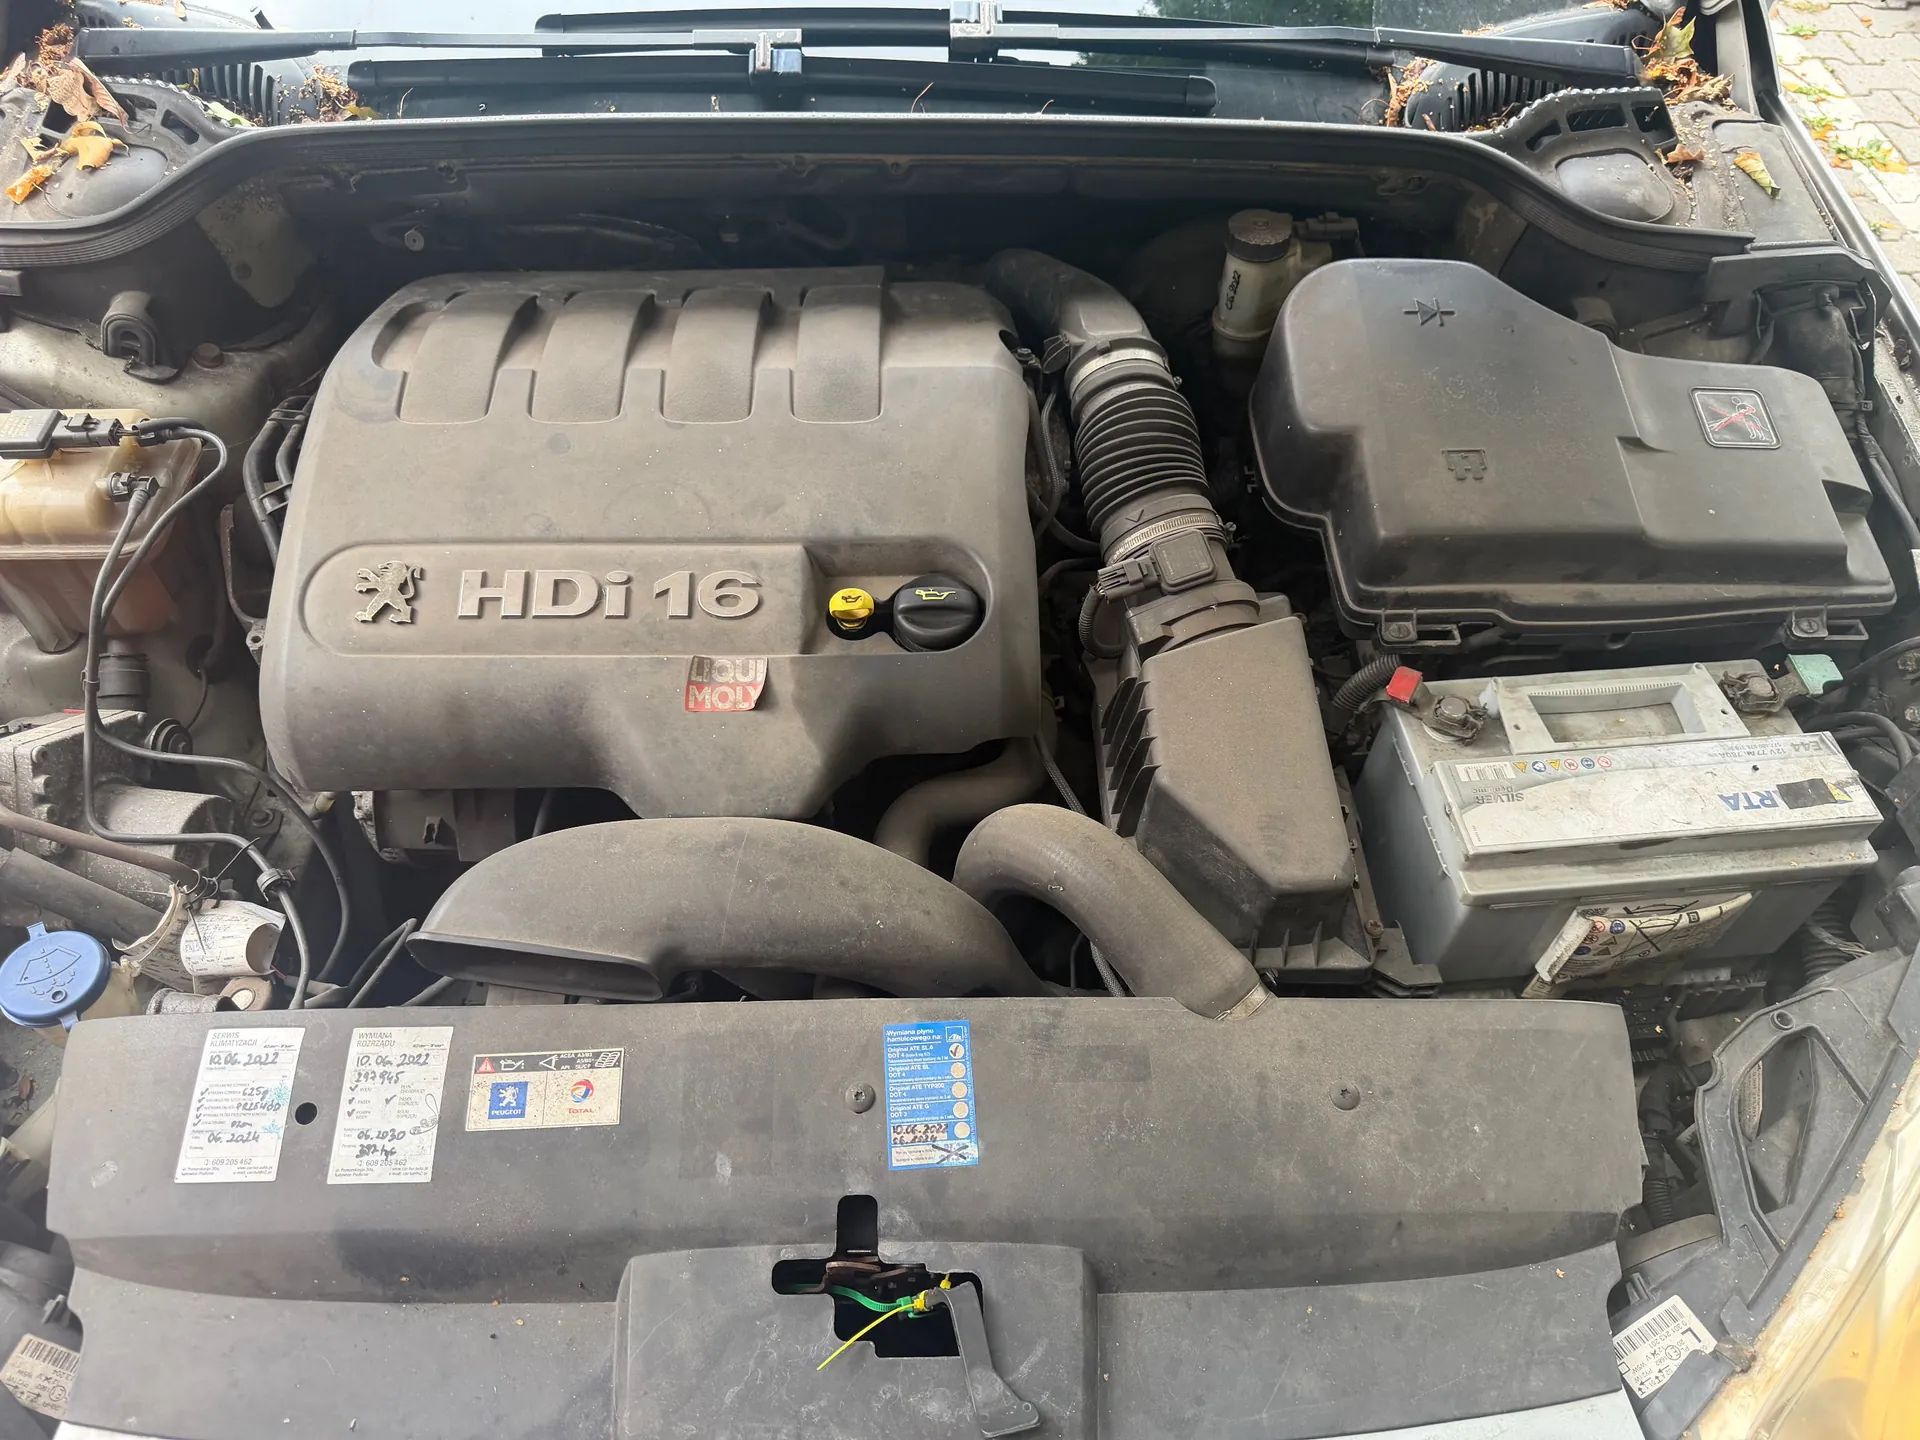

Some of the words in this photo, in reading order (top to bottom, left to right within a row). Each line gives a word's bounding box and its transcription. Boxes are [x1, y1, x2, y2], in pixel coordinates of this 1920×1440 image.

[457, 568, 631, 621] HDi
[654, 570, 763, 619] 16
[690, 657, 765, 684] LIQUI
[688, 685, 761, 710] MOLY
[1790, 740, 1823, 753] E44
[1476, 792, 1525, 805] SILVER
[1717, 789, 1783, 811] RTA
[211, 1031, 240, 1040] SERWIS
[358, 1031, 393, 1039] WYMIANA
[887, 1029, 916, 1037] Wymiana
[209, 1039, 258, 1047] KLIMATYZACJI
[887, 1034, 931, 1043] hamulcowego
[356, 1039, 396, 1049] ROZRZĄDU
[888, 1065, 910, 1073] Original
[889, 1084, 911, 1093] Original
[491, 1108, 523, 1116] PEUGEOT
[889, 1104, 912, 1112] Original
[1681, 1326, 1702, 1344] L
